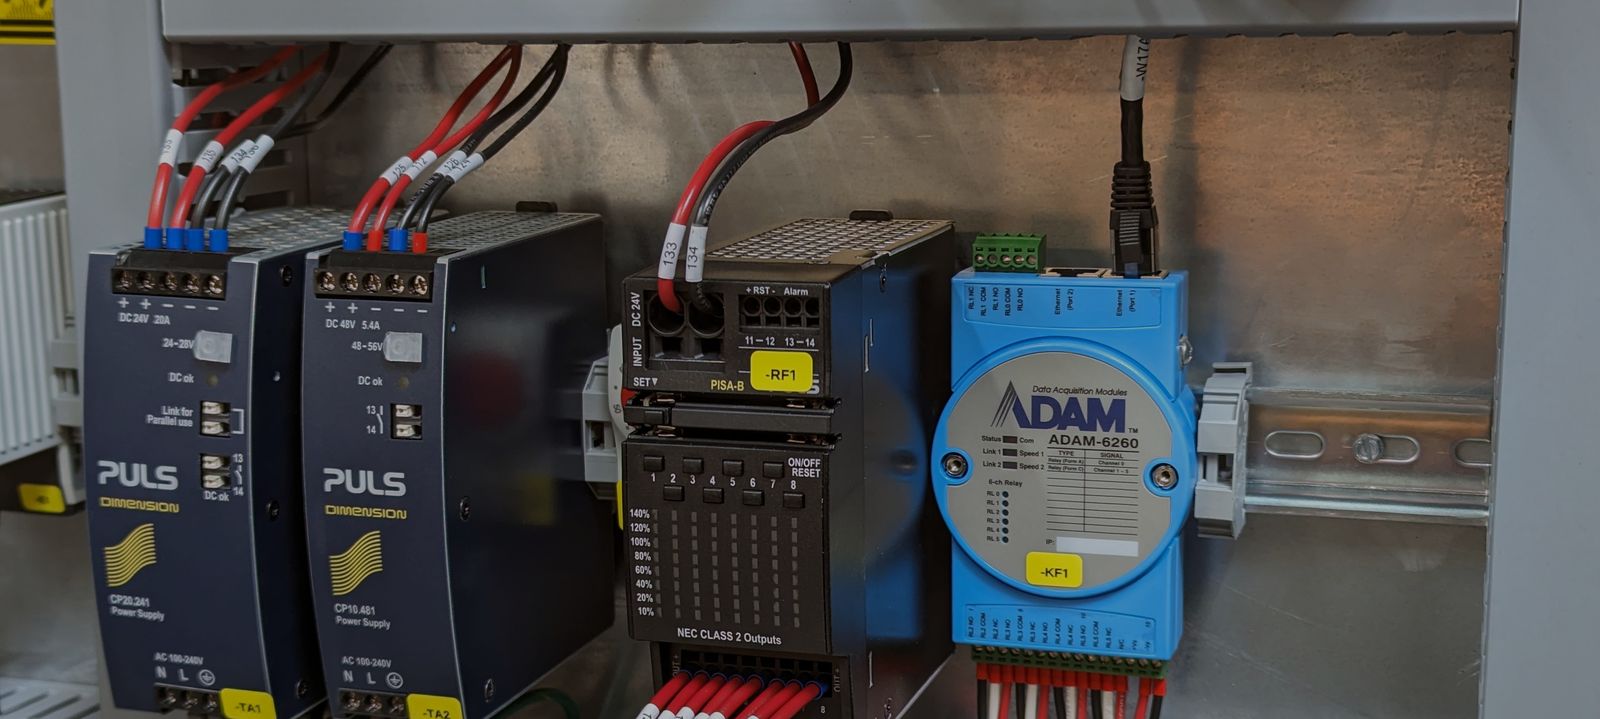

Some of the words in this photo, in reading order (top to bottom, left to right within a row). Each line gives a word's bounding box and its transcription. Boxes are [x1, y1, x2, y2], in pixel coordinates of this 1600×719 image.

[663, 242, 677, 266] 133
[688, 246, 698, 269] 134
[753, 286, 770, 294] RST
[784, 287, 809, 296] Alarm
[1017, 288, 1024, 298] NO
[630, 292, 641, 311] 24V
[118, 312, 132, 322] DC
[133, 313, 150, 323] 24V
[153, 314, 170, 325] 20A
[632, 312, 641, 327] DC
[326, 319, 338, 328] DC
[340, 320, 356, 329] 48V
[361, 321, 380, 330] 5.4A
[745, 336, 753, 345] 11
[766, 337, 775, 346] 12
[785, 338, 794, 346] 13
[805, 338, 815, 347] 14
[633, 337, 642, 367] INPUT
[168, 372, 182, 383] DC
[183, 373, 194, 383] ok
[765, 369, 796, 381] -RF1
[358, 376, 371, 385] DC
[372, 377, 383, 386] ok
[633, 377, 650, 387] SET
[710, 380, 745, 391] PISA-B
[1032, 385, 1052, 393] Data
[1052, 386, 1094, 395] Acquisition
[1095, 388, 1128, 396] Modules
[161, 405, 179, 415] Link
[181, 407, 194, 417] for
[366, 405, 376, 415] 13
[990, 380, 1126, 434] ADAM
[147, 414, 177, 426] Parallel
[178, 418, 193, 427] use
[366, 425, 376, 434] 14
[1048, 434, 1139, 449] ADAM-6260
[233, 453, 243, 463] 13
[1019, 449, 1040, 458] Speed
[788, 457, 821, 468] ON/OFF
[982, 460, 997, 468] Link
[97, 460, 178, 491] PULS
[651, 473, 656, 482] 1
[670, 473, 676, 483] 2
[791, 468, 821, 478] RESET
[323, 467, 407, 497] PULS
[690, 474, 696, 484] 3
[709, 475, 716, 485] 4
[730, 477, 736, 487] 5
[750, 478, 756, 487] 6
[770, 479, 776, 489] 7
[790, 480, 796, 489] 8
[1004, 480, 1023, 488] Relay
[204, 490, 217, 500] DC
[219, 492, 230, 502] ok
[233, 486, 244, 496] 14
[100, 497, 180, 513] DIMENSION
[325, 504, 408, 520] DIMENSION
[629, 508, 650, 519] 140%
[630, 523, 650, 533] 120%
[630, 537, 651, 547] 100%
[634, 551, 651, 561] 80%
[635, 565, 652, 575] 60%
[1040, 567, 1068, 578] -KF1
[635, 579, 653, 589] 40%
[109, 594, 150, 607] CP20.241
[636, 593, 653, 603] 20%
[110, 606, 136, 617] Power
[137, 609, 165, 622] Supply
[334, 603, 376, 615] CP10.481
[638, 607, 654, 616] 10%
[335, 616, 361, 626] Power
[363, 617, 391, 630] Supply
[677, 627, 698, 638] NEC
[700, 629, 734, 641] CLASS
[735, 632, 741, 642] 2
[743, 632, 782, 646] Outputs
[154, 652, 168, 662] AC
[169, 653, 204, 665] 100-240V
[342, 656, 354, 665] AC
[356, 657, 392, 668] 100-240V
[156, 666, 167, 679] N
[180, 669, 189, 681] L
[343, 670, 353, 682] N
[367, 672, 376, 684] L
[235, 702, 261, 713] -TA1
[423, 708, 450, 719] -TA2
